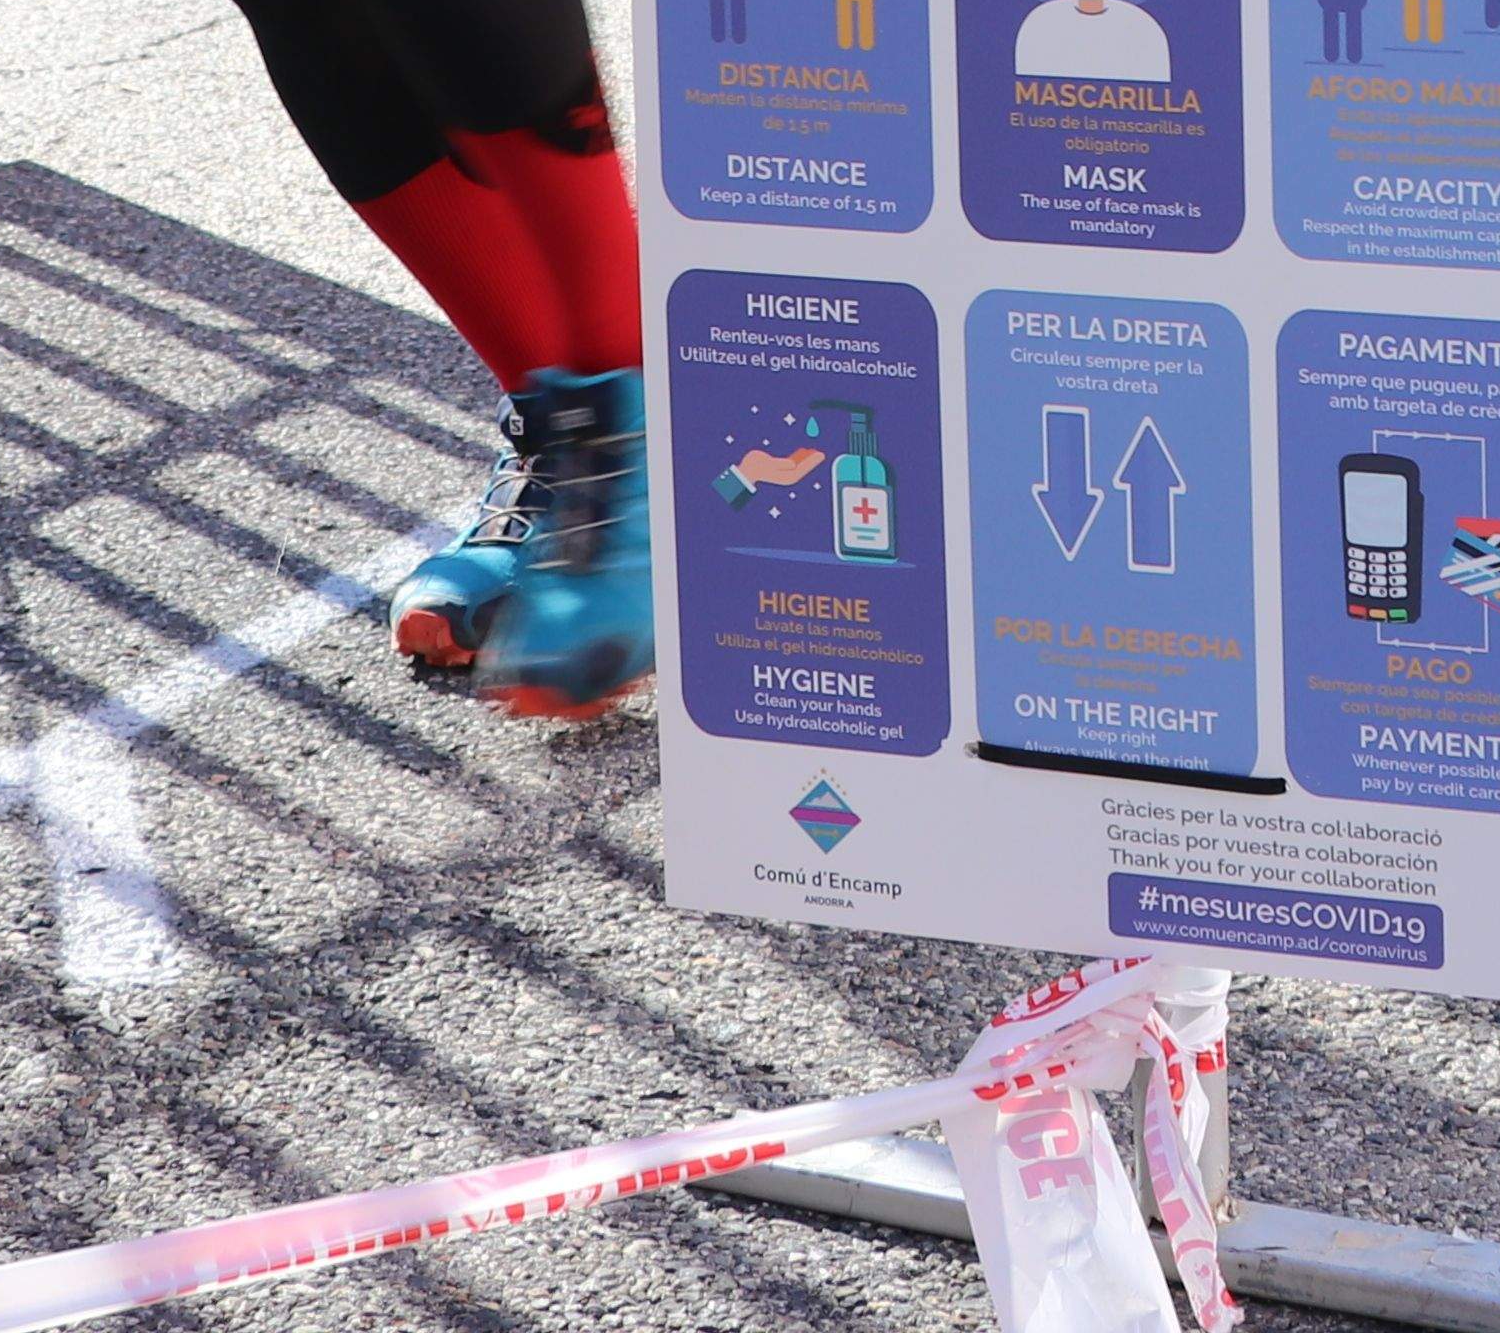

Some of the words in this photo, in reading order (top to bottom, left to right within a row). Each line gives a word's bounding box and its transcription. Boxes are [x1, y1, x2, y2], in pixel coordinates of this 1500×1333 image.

[720, 63, 870, 93] DISTANCIA
[1309, 76, 1413, 104] AFORO
[1015, 81, 1201, 113] MASCARILLA
[728, 155, 867, 186] DISTANCE
[1064, 165, 1147, 192] MASK
[700, 187, 743, 206] Keep
[746, 193, 757, 204] a
[760, 191, 830, 209] distance
[833, 195, 851, 210] of
[880, 201, 897, 213] m
[1020, 193, 1051, 209] The
[1054, 199, 1082, 211] use
[1085, 197, 1102, 211] of
[1104, 198, 1139, 214] face
[1142, 202, 1185, 217] mask
[1188, 206, 1201, 217] is
[1343, 202, 1387, 217] Avoid
[1390, 206, 1459, 220] crowded
[1070, 220, 1155, 239] mandatory
[1303, 218, 1365, 236] Respect
[1369, 223, 1394, 237] the
[1398, 227, 1473, 241] maximum
[1347, 241, 1361, 254] in
[1364, 242, 1390, 256] the
[747, 294, 859, 324] HIGIENE
[710, 327, 804, 347] Renteu-vos
[807, 334, 832, 350] les
[835, 339, 880, 353] mans
[1008, 311, 1062, 338] PER
[1070, 316, 1107, 341] LA
[1113, 319, 1208, 348] DRETA
[680, 346, 747, 365] Utilitzeu
[750, 352, 767, 367] el
[770, 354, 797, 371] gel
[1299, 368, 1367, 389] Sempre
[1371, 376, 1406, 392] que
[1329, 394, 1369, 410] amb
[1373, 397, 1437, 417] targeta
[1441, 400, 1465, 416] de
[759, 591, 870, 622] HIGIENE
[995, 617, 1053, 645] POR
[1060, 626, 1097, 648] LA
[1104, 627, 1242, 661] DERECHA
[754, 665, 875, 698] HYGIENE
[1387, 655, 1473, 685] PAGO
[754, 692, 797, 709] Clean
[800, 700, 834, 713] your
[837, 700, 882, 717] hands
[1014, 694, 1057, 719] ON
[1064, 698, 1122, 726] THE
[1130, 705, 1219, 734] RIGHT
[735, 709, 764, 725] Use
[767, 712, 876, 736] hydroalcoholic
[879, 725, 904, 741] gel
[1078, 726, 1118, 745] Keep
[1121, 731, 1157, 748] right
[1352, 753, 1433, 774] Whenever
[1362, 777, 1391, 793] pay
[1394, 777, 1414, 795] by
[1418, 782, 1465, 797] credit
[1101, 798, 1175, 821] Gràcies
[1181, 810, 1214, 826] per
[1220, 809, 1238, 827] la
[1243, 816, 1306, 834] vostra
[1107, 824, 1180, 847] Gracias
[1186, 835, 1219, 852] por
[1224, 839, 1299, 859] vuestra
[1305, 846, 1438, 872] colaboración
[754, 864, 806, 885] Comú
[1109, 848, 1169, 869] Thank
[1175, 858, 1212, 875] you
[1217, 858, 1245, 876] for
[1250, 866, 1296, 883] your
[1301, 869, 1436, 896] collaboration
[804, 895, 854, 908] ANDORRA
[1139, 887, 1425, 941] #mesuresCOVID19
[1133, 921, 1427, 962] www.comuencamp.ad/coronavirus
